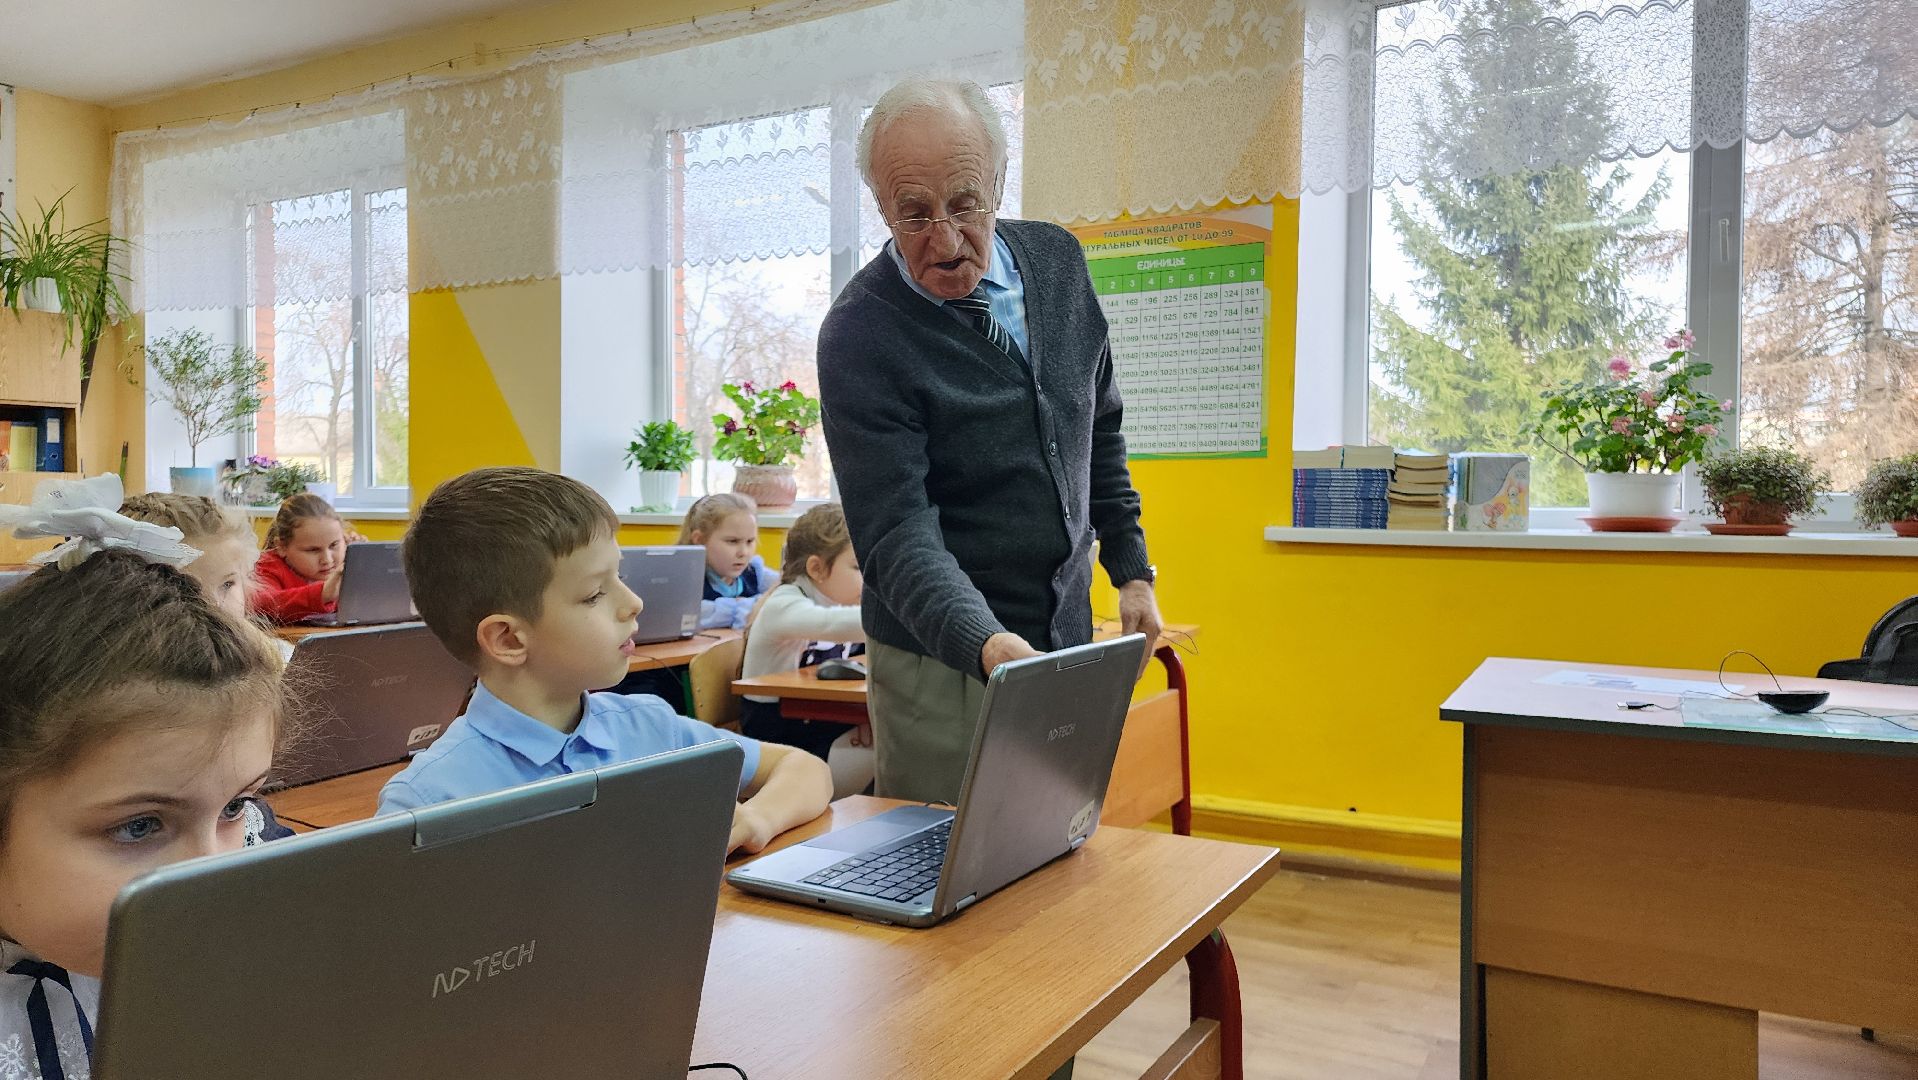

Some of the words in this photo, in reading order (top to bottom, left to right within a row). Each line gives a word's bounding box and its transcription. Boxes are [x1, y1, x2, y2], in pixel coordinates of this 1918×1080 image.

[1104, 227, 1143, 239] ТАБЛИЦА
[1147, 221, 1202, 234] КВАДРАТОВ
[1144, 235, 1174, 247] ЧИСЕЛ
[1177, 234, 1188, 243] ОТ
[1205, 231, 1219, 241] ДО
[1137, 257, 1186, 271] ЕДИНИЦЫ
[1110, 281, 1115, 289] 2
[1168, 276, 1173, 284] 5
[1188, 274, 1194, 282] 6
[1250, 268, 1255, 276] 9
[432, 940, 536, 998] NDTECH
